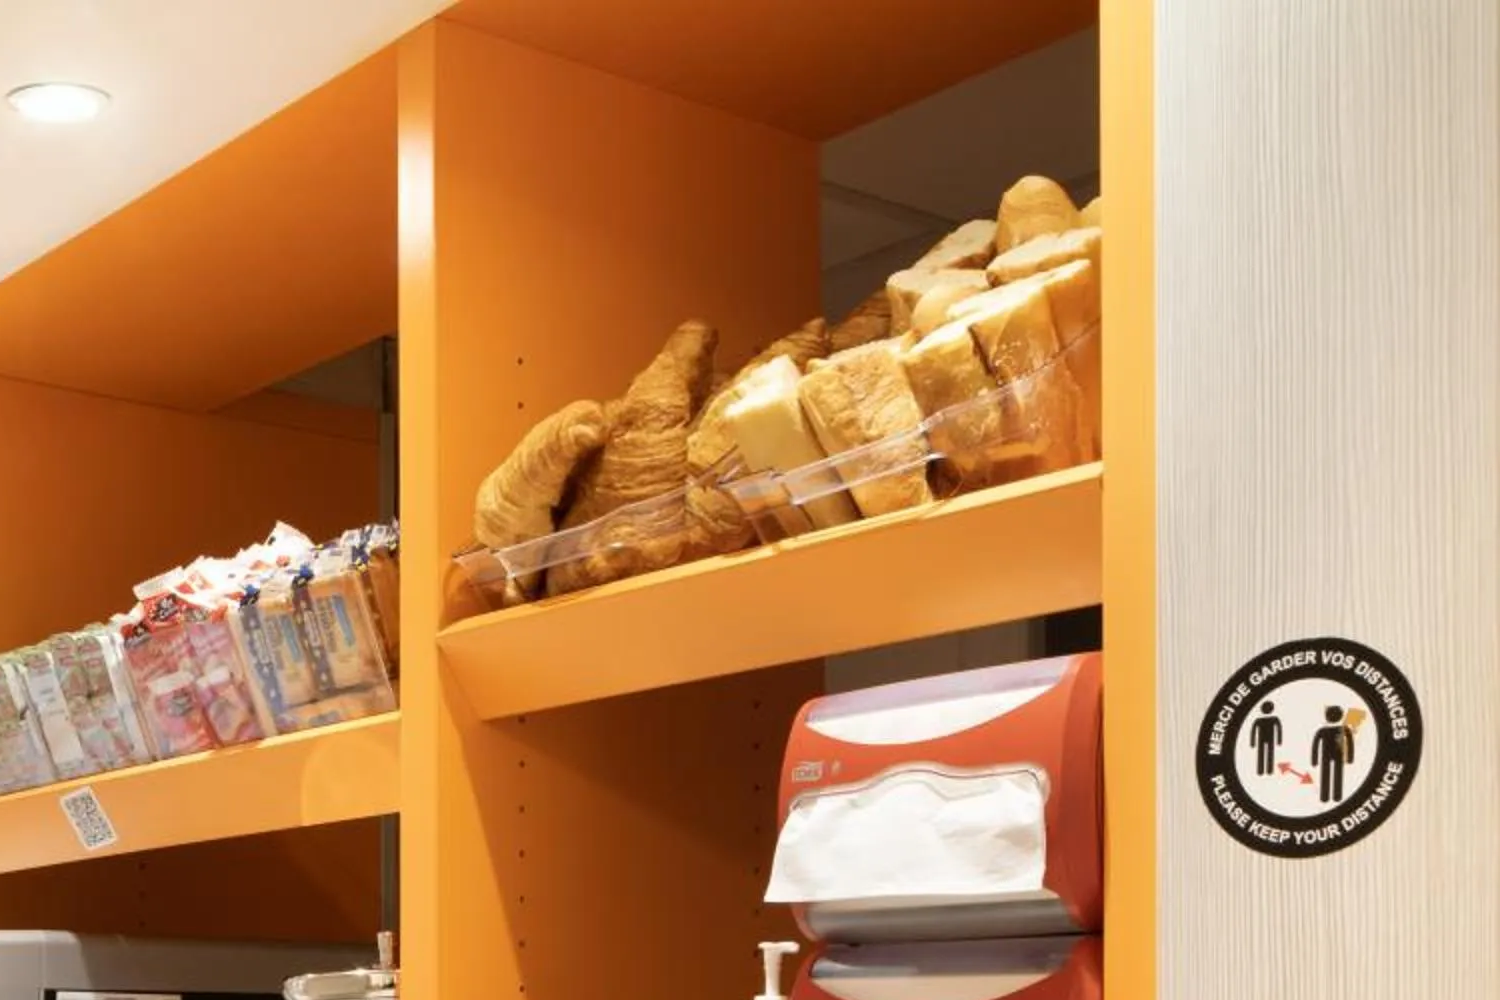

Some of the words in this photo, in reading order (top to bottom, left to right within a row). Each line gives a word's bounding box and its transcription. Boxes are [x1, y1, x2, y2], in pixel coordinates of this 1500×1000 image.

[1209, 705, 1235, 755] MERCI
[1230, 685, 1251, 706] DE
[1249, 651, 1317, 686] GARDER
[1321, 650, 1355, 670] VOS
[1354, 662, 1409, 740] DISTANCES
[1210, 774, 1250, 828] PLEASE
[1249, 820, 1290, 843] KEEP
[1293, 824, 1341, 845] YOUR
[1343, 761, 1404, 832] DISTANCE
